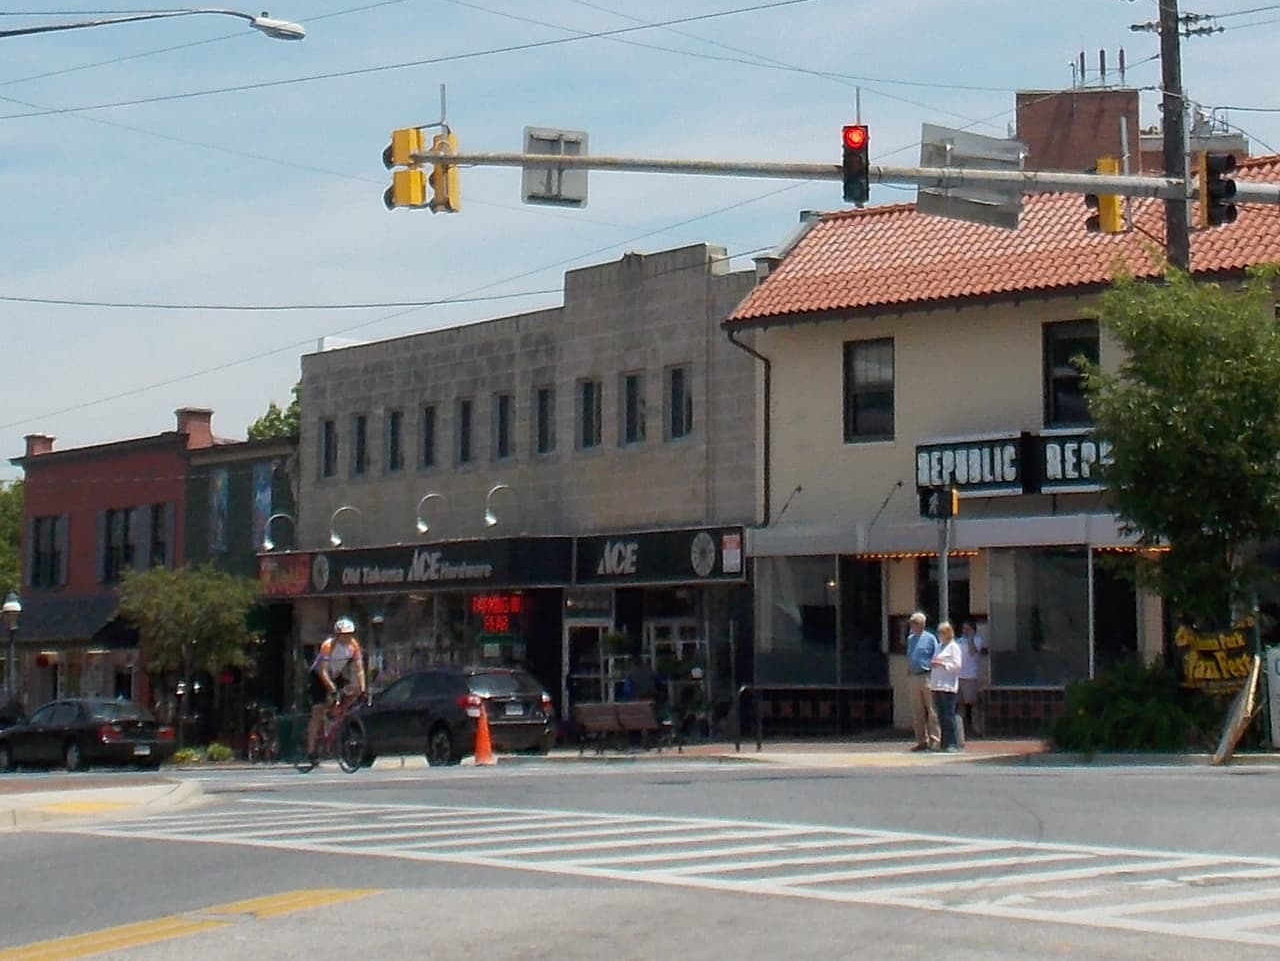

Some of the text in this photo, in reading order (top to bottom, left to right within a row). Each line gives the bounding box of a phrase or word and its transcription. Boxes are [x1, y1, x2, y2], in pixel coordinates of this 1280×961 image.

[918, 445, 1017, 488] REPUBLIC
[405, 548, 443, 582] ACE
[597, 539, 639, 576] ACE
